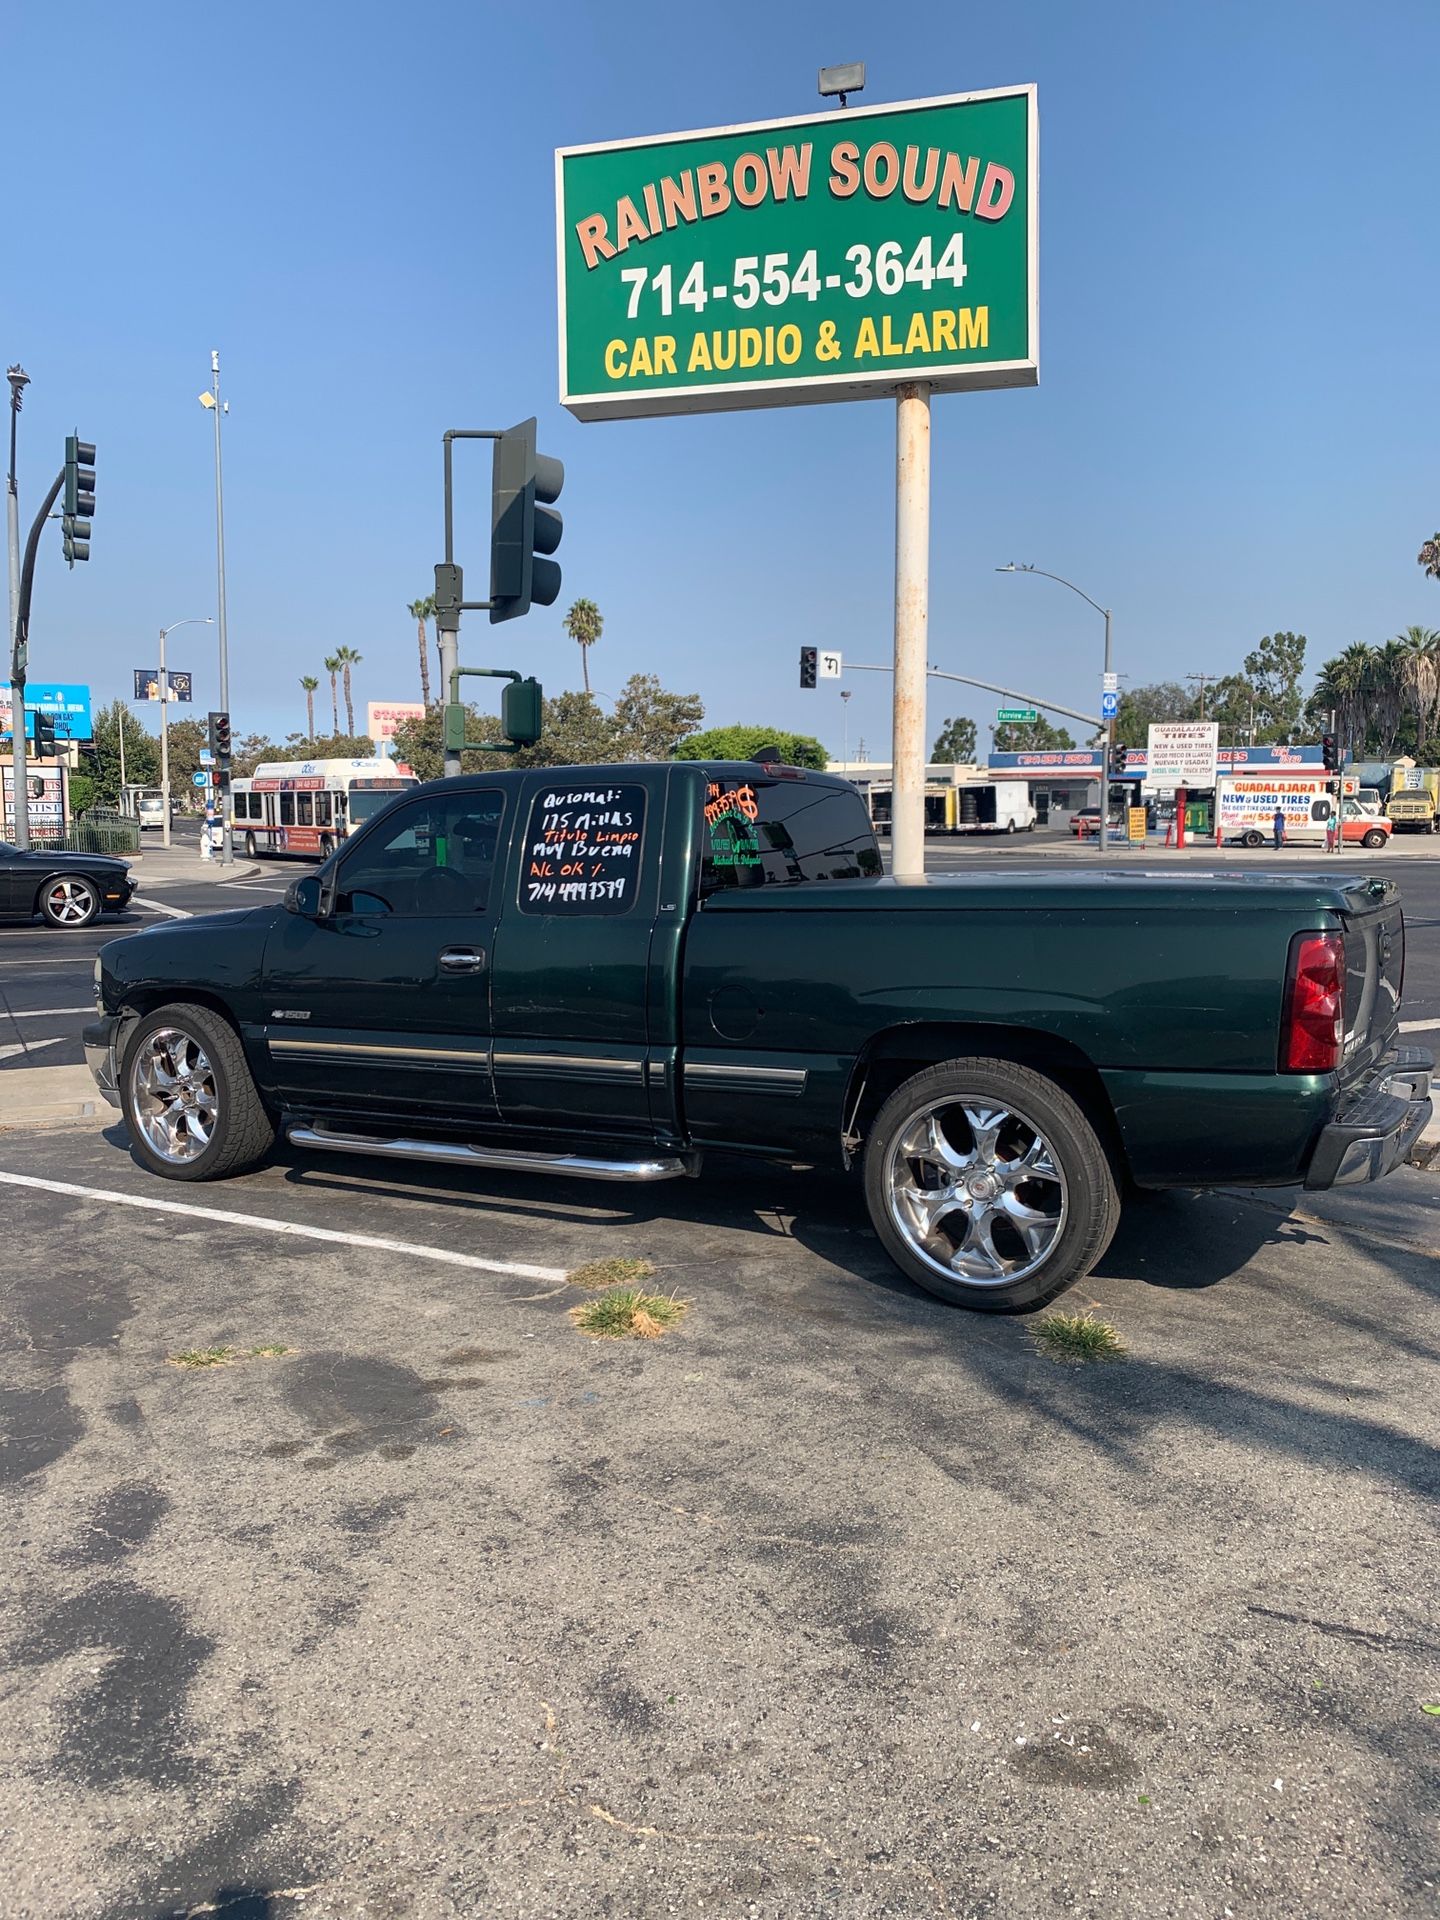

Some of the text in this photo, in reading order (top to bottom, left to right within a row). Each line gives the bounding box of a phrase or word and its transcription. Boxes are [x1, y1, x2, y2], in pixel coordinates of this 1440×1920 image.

[576, 141, 1015, 269] RAINBOW SOUND
[621, 232, 967, 319] 714-554-3644
[604, 306, 988, 379] CAR AUDIO & ALARM
[1217, 751, 1248, 762] IRES
[1234, 783, 1316, 793] GUADALAJARA
[737, 783, 758, 824] $
[1222, 795, 1245, 803] NEW
[1253, 795, 1278, 804] USED
[1281, 795, 1311, 804] TIRES
[544, 829, 639, 844] Titulo Limpio
[571, 841, 633, 858] Buena
[560, 861, 584, 876] OK
[528, 882, 556, 902] 714
